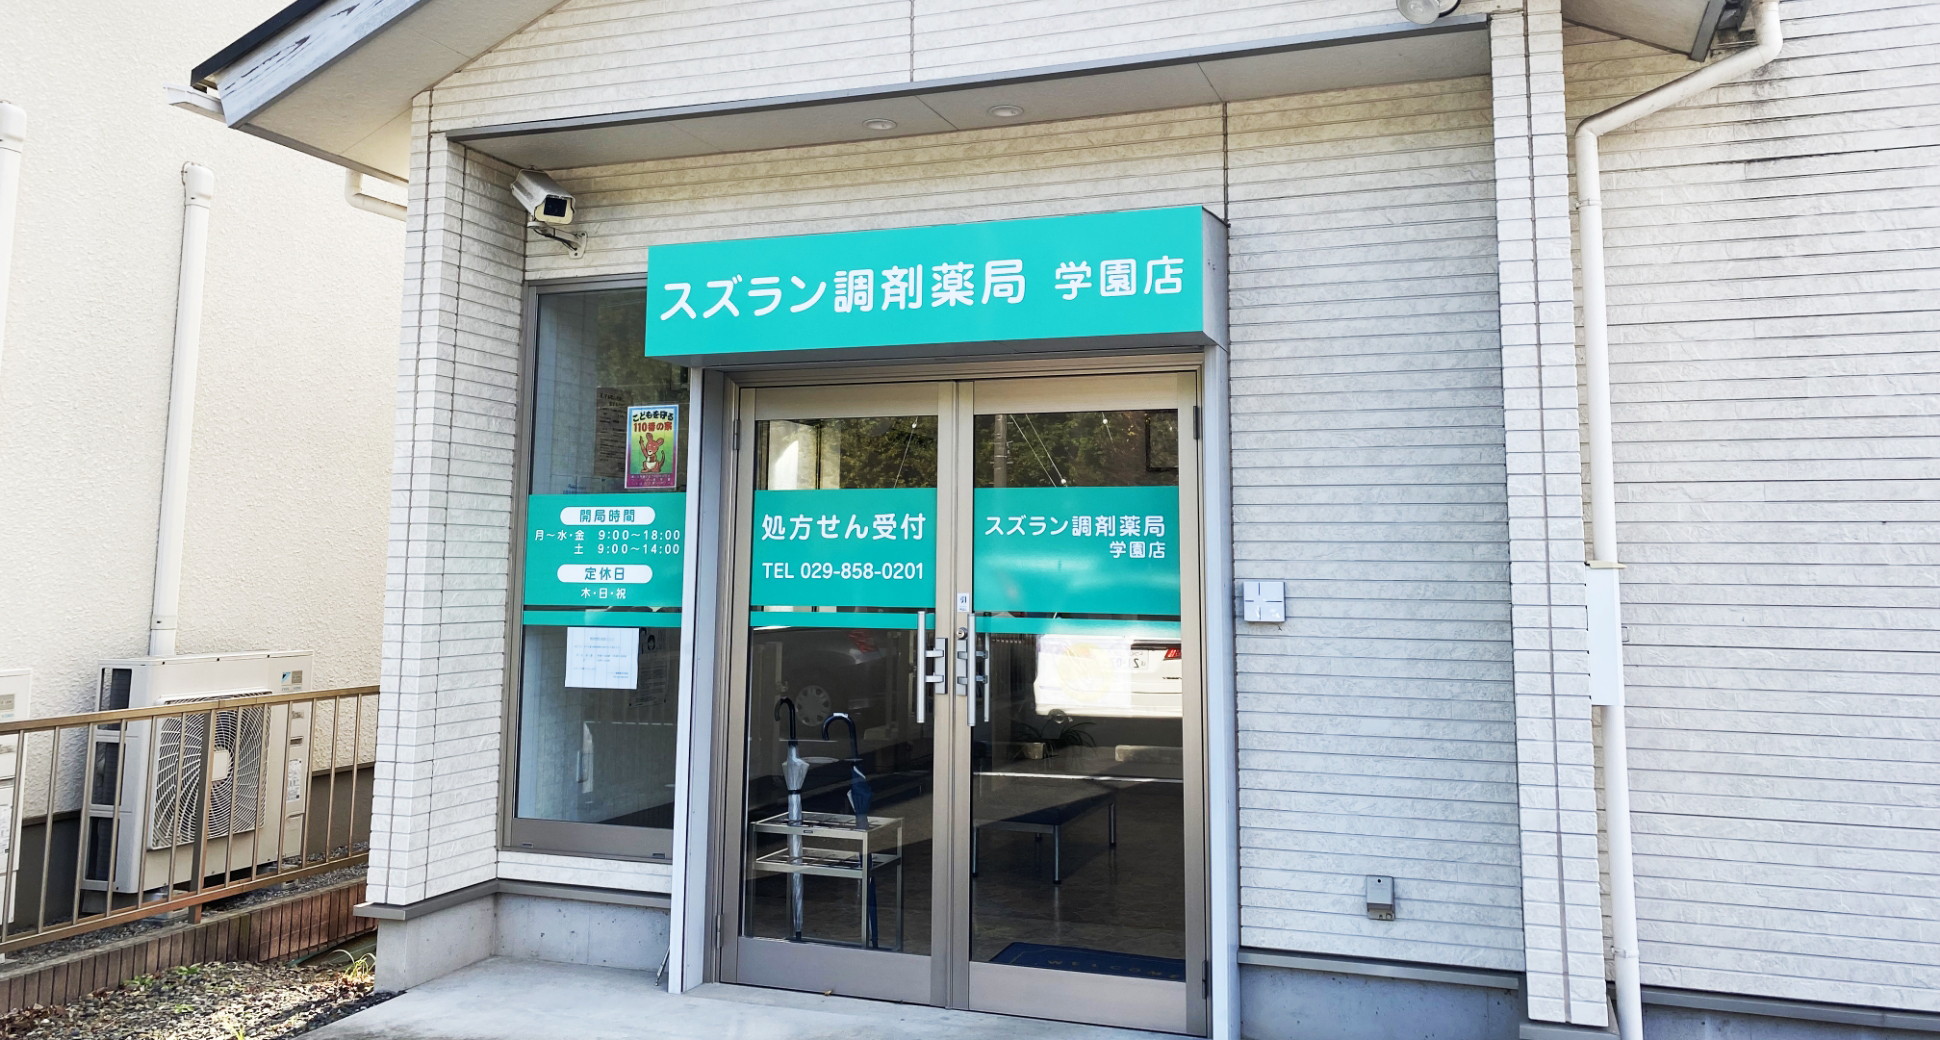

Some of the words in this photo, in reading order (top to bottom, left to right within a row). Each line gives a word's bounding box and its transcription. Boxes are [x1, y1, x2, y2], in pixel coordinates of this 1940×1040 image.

[660, 259, 1025, 321] スズラン調剤薬局
[1054, 255, 1185, 301] 学園店
[632, 410, 674, 422] こどもを守る
[633, 421, 672, 432] 110番の家
[579, 509, 635, 523] 開局時間
[761, 512, 926, 541] 処方せん受付
[985, 514, 1165, 537] スズラン調剤薬局
[598, 529, 680, 541] 9:00〜18:00
[574, 543, 584, 555] 土
[598, 543, 680, 555] 9:00〜14:00
[1109, 541, 1165, 559] 学園店
[584, 566, 625, 581] 定休日
[762, 562, 795, 579] TEL
[801, 562, 923, 580] 029-858-0201
[581, 587, 626, 599] 木・日・祝
